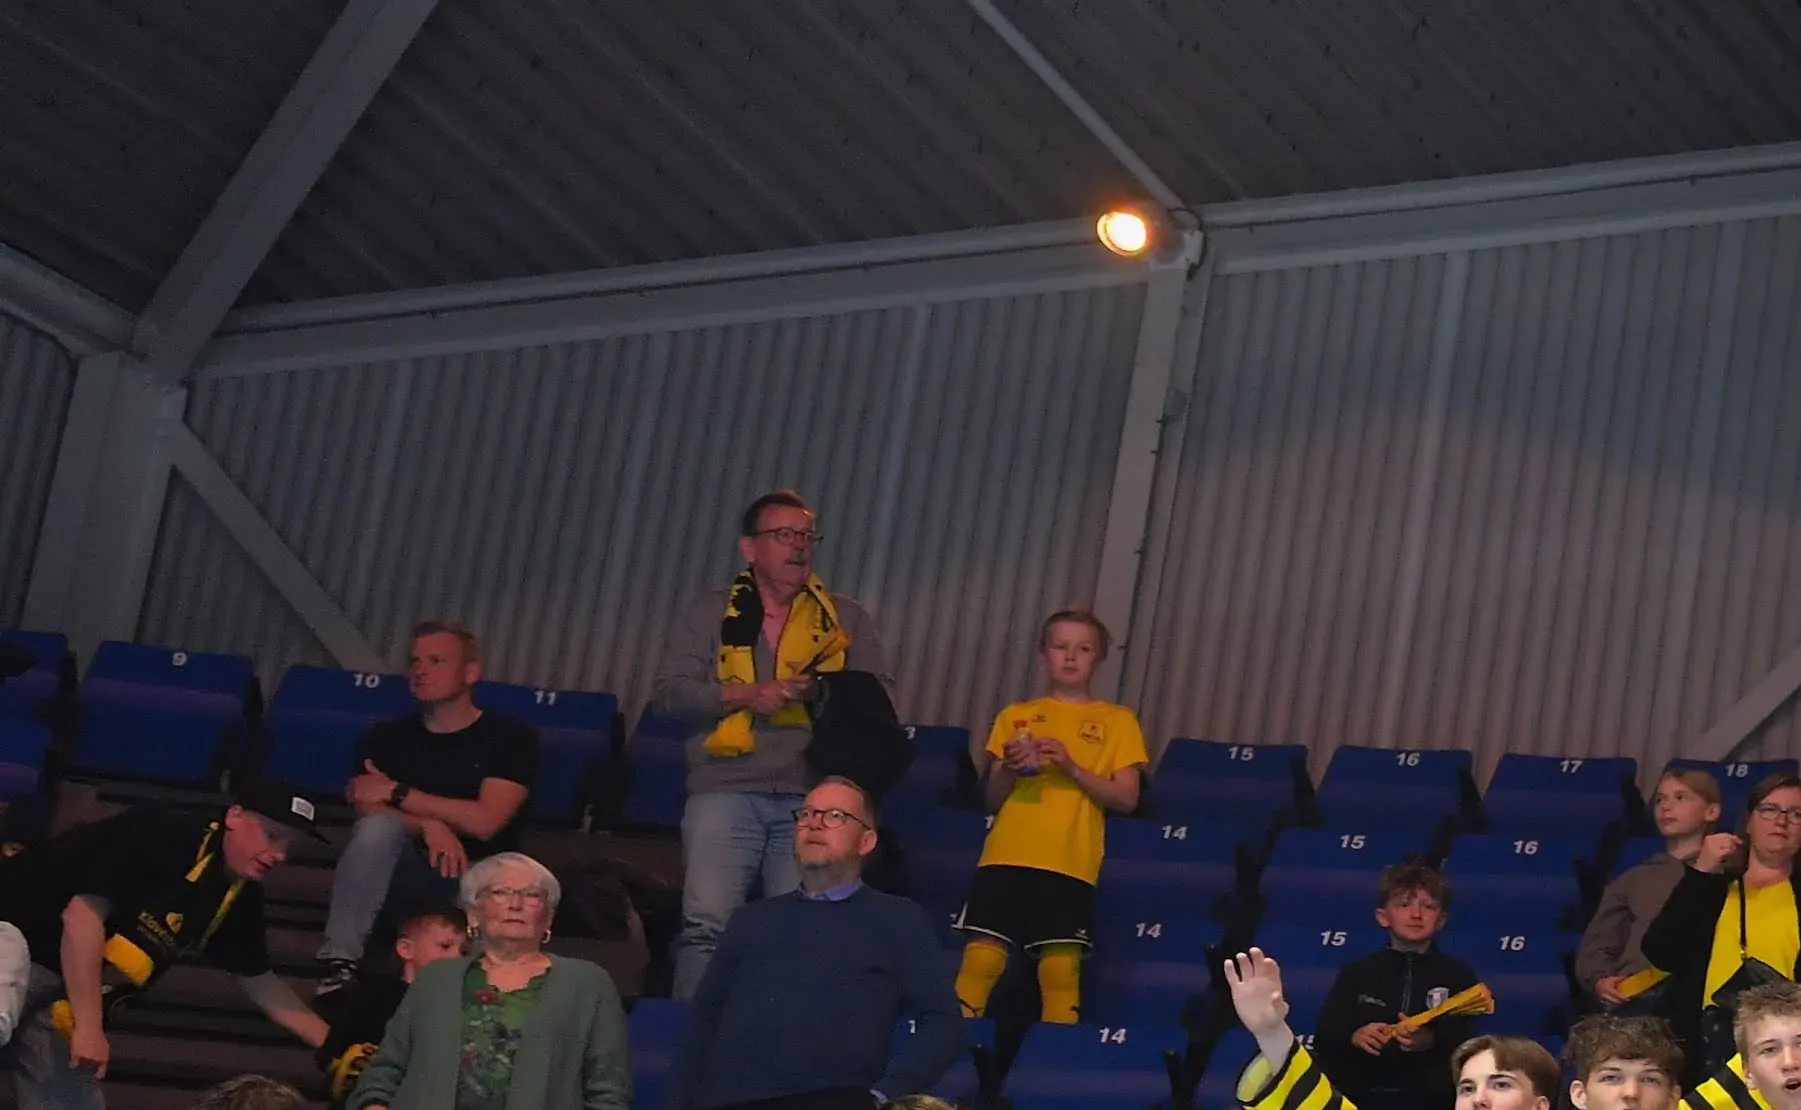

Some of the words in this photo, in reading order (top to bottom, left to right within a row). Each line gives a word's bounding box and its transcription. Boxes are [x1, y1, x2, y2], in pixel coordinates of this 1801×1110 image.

[172, 651, 187, 667] 9
[353, 672, 380, 689] 10
[532, 688, 557, 706] 11
[1227, 746, 1255, 762] 15
[1395, 752, 1421, 768] 16
[1559, 758, 1584, 774] 17
[1723, 763, 1749, 779] 18
[1160, 824, 1189, 841] 14
[1339, 833, 1367, 850] 15
[1512, 839, 1539, 856] 16
[1134, 921, 1163, 939] 14
[1318, 930, 1347, 947] 15
[1498, 935, 1526, 952] 16
[1097, 1027, 1127, 1045] 14
